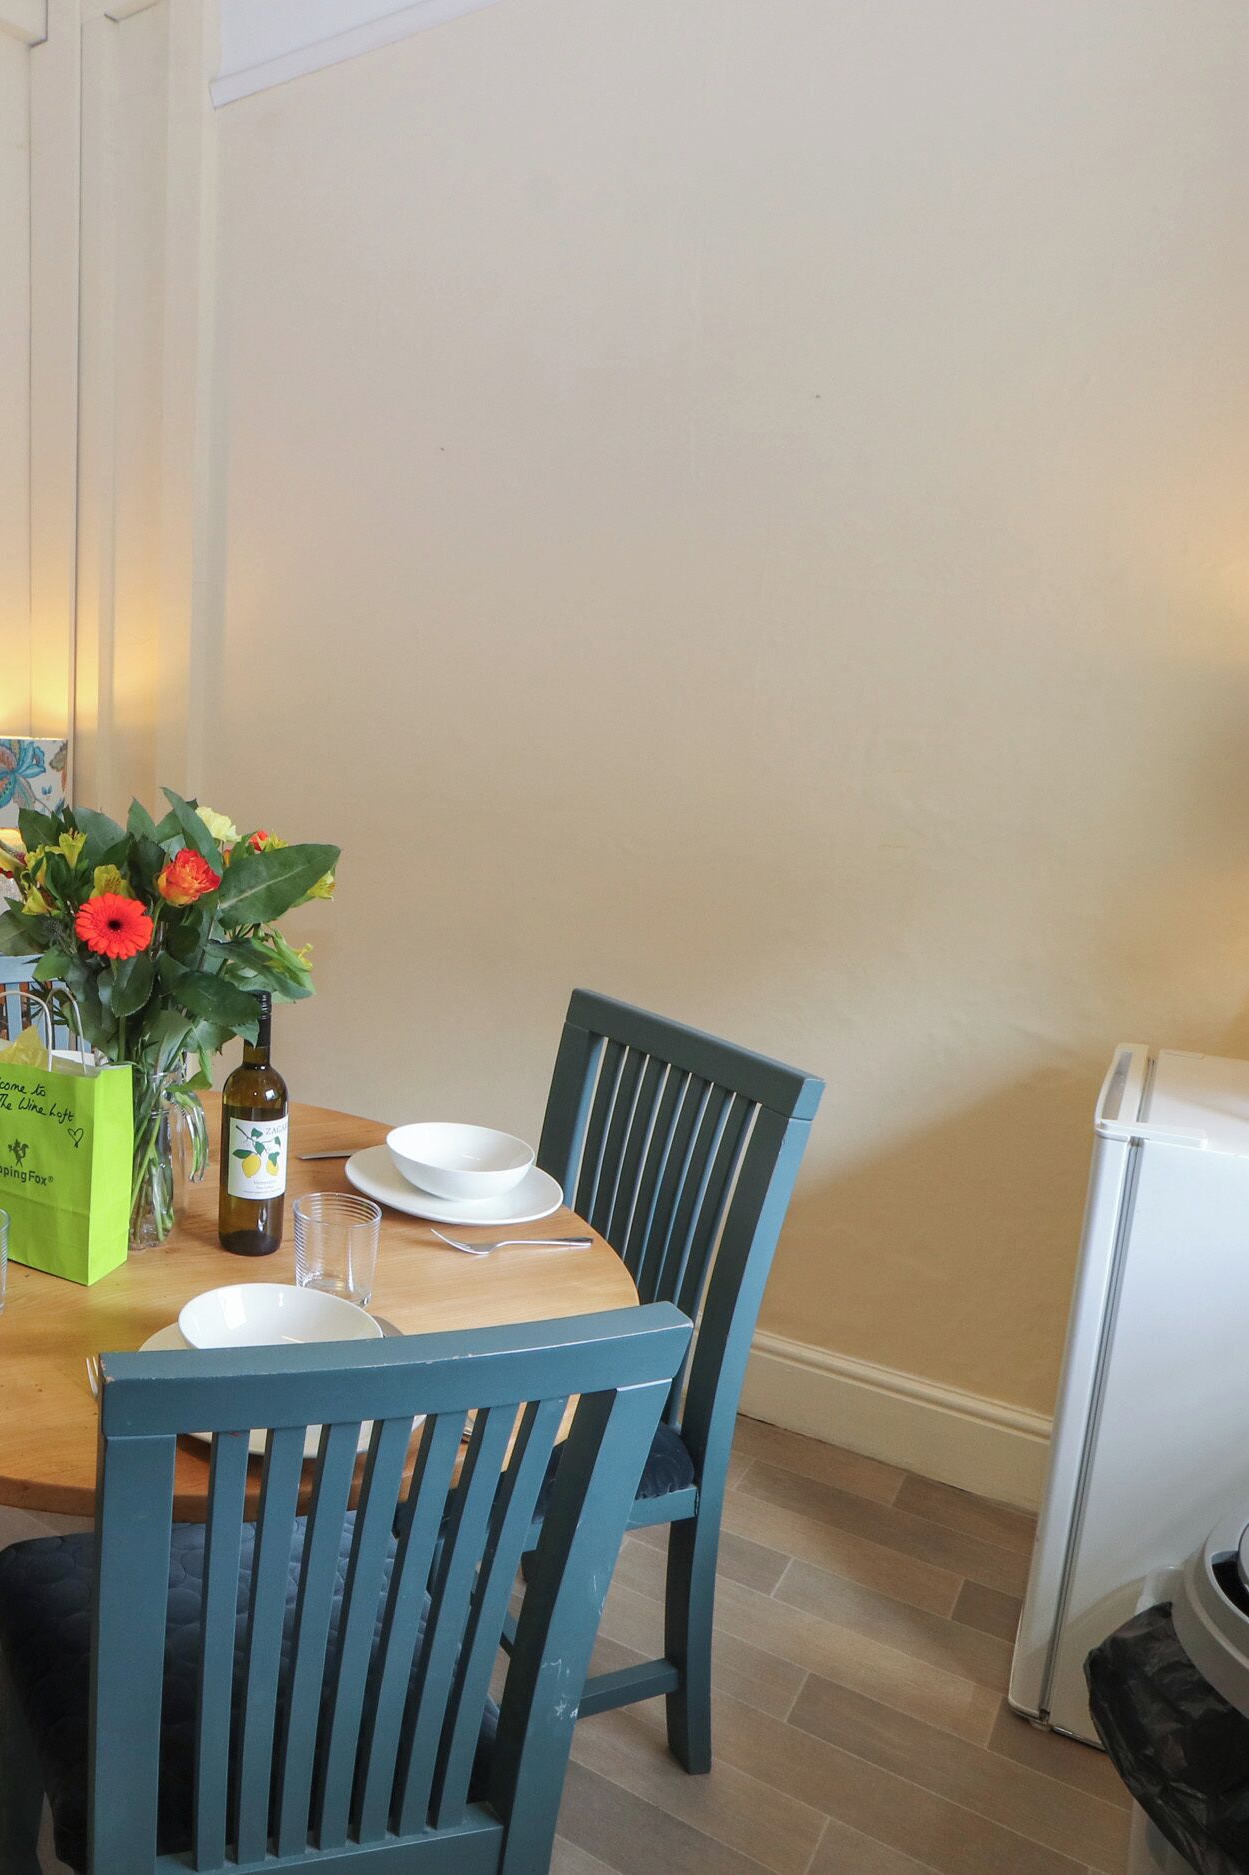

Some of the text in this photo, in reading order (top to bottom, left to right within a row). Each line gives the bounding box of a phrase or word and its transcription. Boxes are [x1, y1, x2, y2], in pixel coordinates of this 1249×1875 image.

[31, 1083, 46, 1097] to
[18, 1096, 47, 1116] Wine
[47, 1102, 75, 1124] Loft
